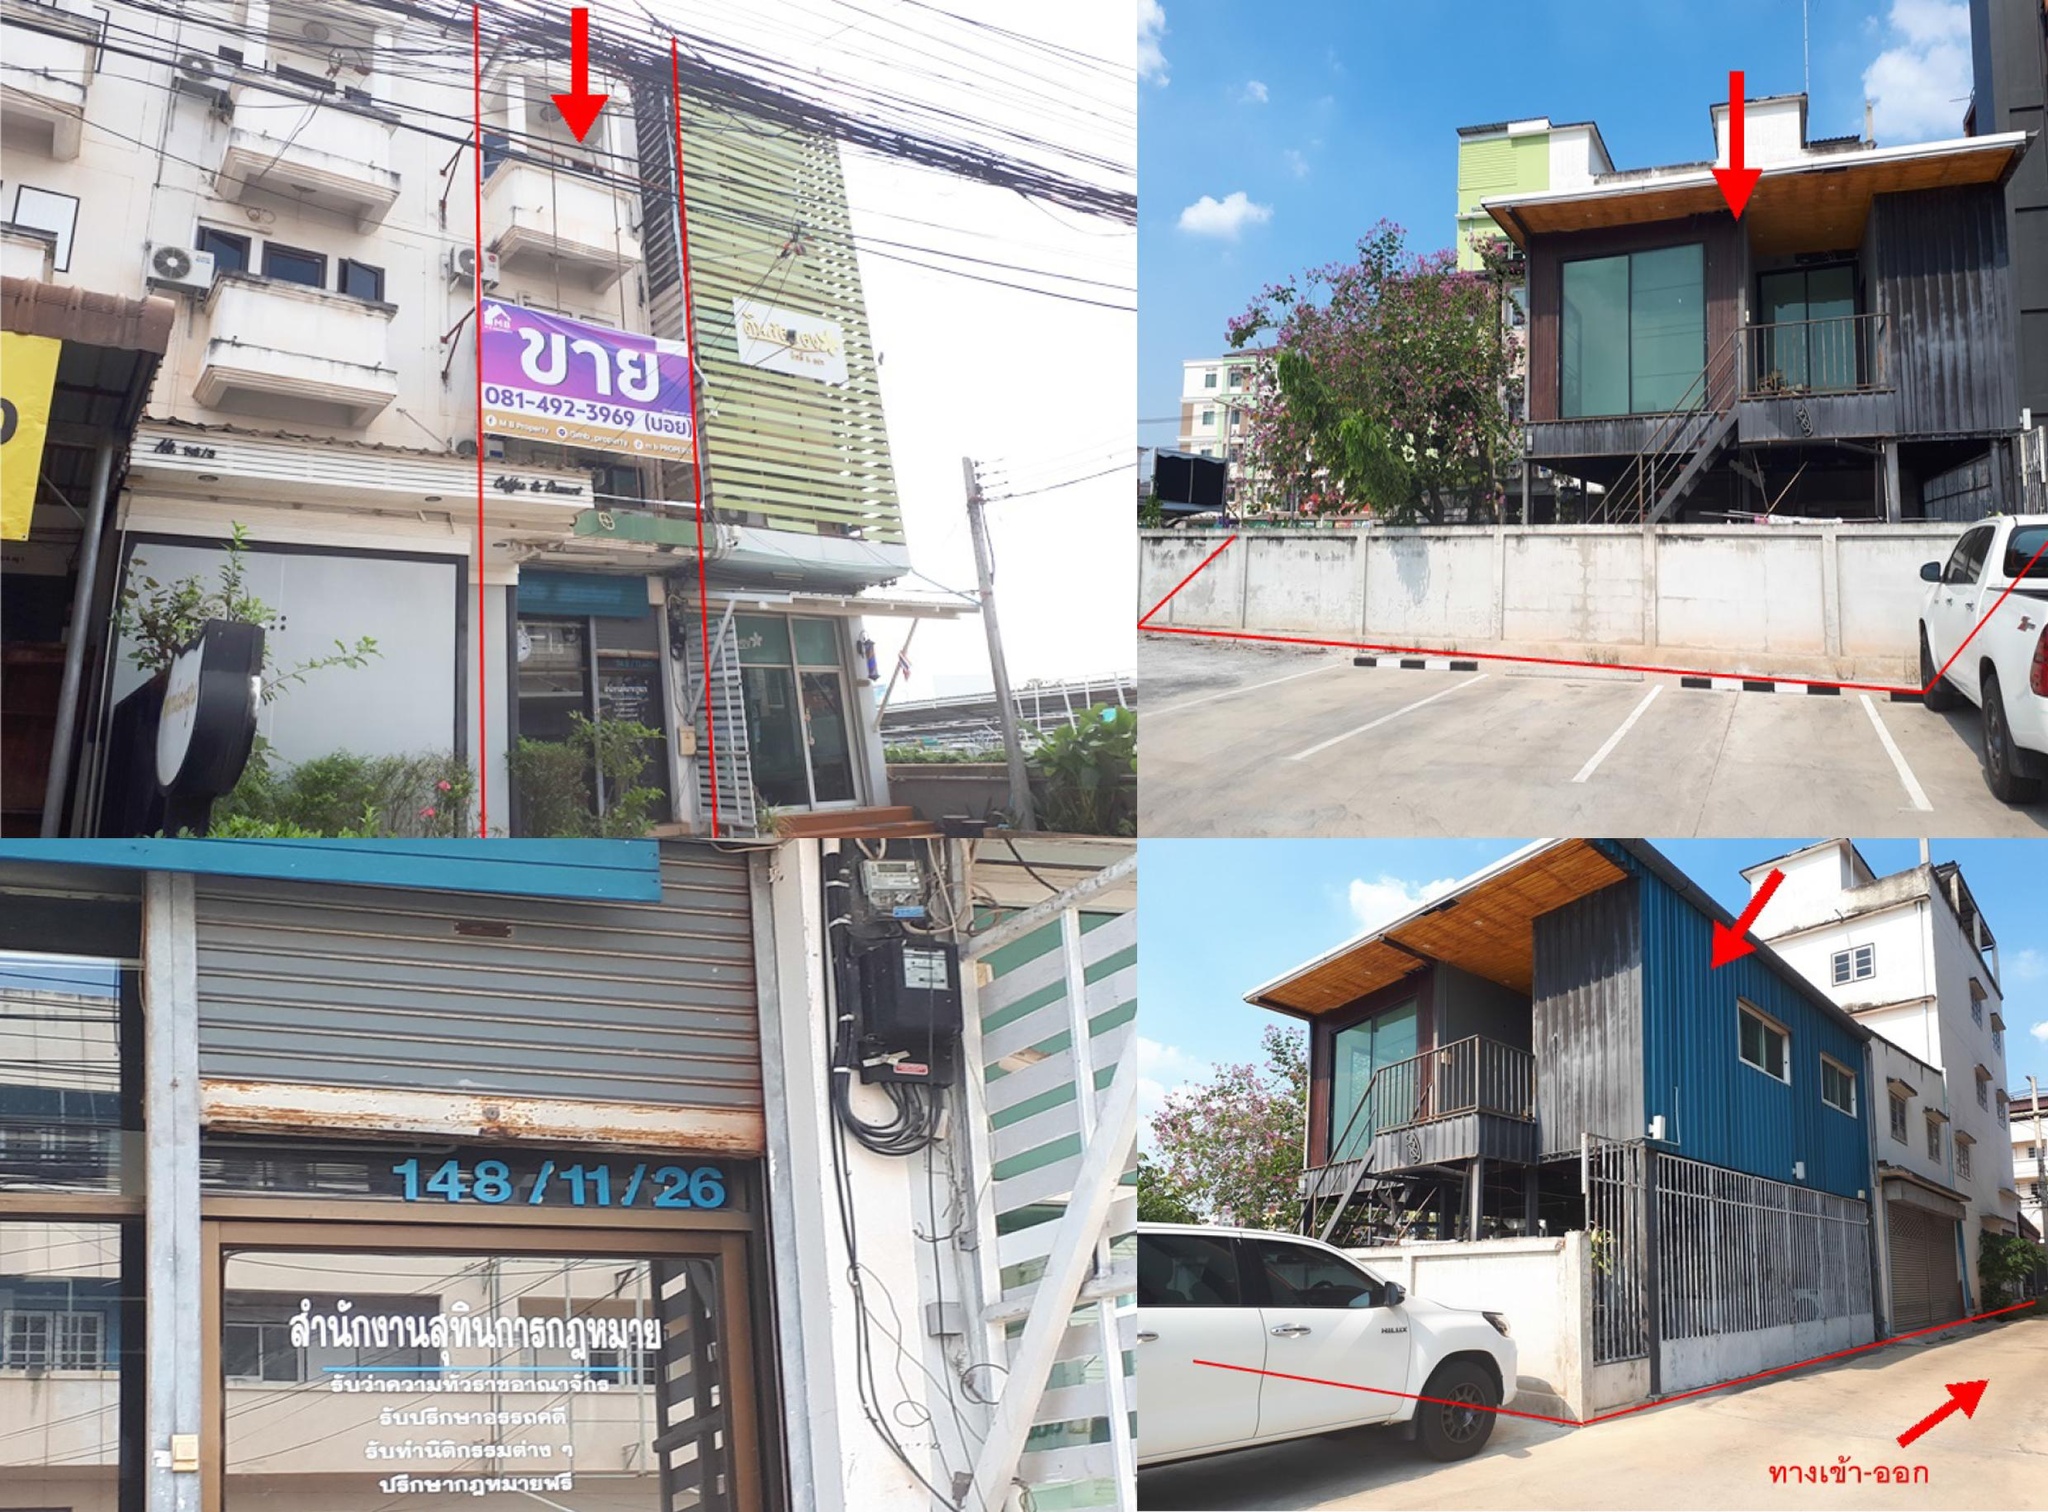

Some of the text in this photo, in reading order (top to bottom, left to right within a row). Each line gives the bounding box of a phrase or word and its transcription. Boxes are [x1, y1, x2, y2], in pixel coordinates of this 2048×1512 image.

[518, 327, 660, 403] ขาย
[485, 386, 692, 438] 081-492-3969 (บอย)
[289, 1298, 662, 1367] สำนักงานสุทินการกฎหมาย
